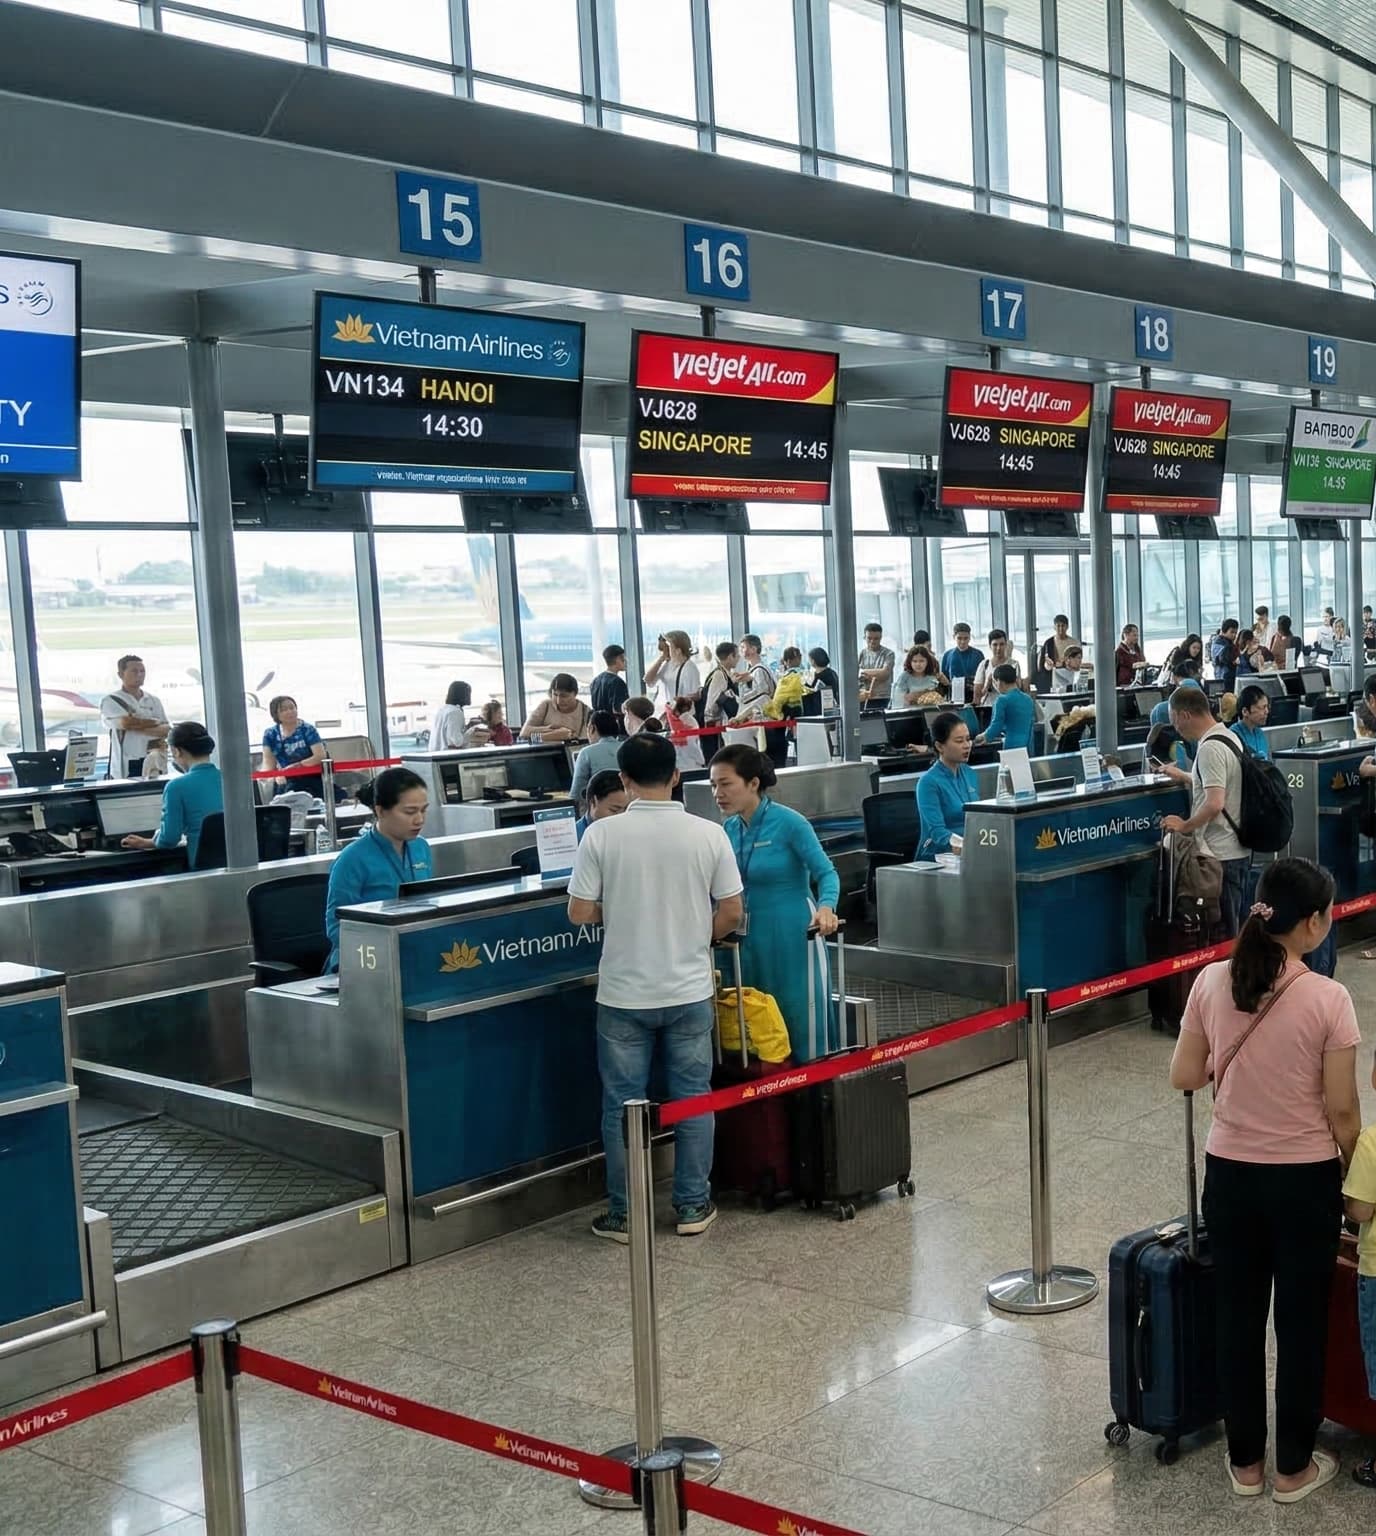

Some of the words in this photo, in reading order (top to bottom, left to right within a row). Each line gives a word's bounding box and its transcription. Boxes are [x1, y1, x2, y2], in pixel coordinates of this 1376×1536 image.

[408, 188, 473, 246] 15
[693, 238, 743, 288] 16
[987, 289, 1023, 329] 17
[1140, 315, 1169, 352] 18
[1312, 345, 1336, 378] 19
[326, 370, 404, 398] VN134
[421, 378, 493, 404] HANOI
[640, 398, 697, 421] VJ628
[422, 413, 483, 438] 14:30
[950, 423, 990, 442] VJ628
[1000, 427, 1076, 448] SINGAPORE
[1304, 421, 1355, 439] BAMBOO
[639, 430, 752, 455] SINGAPORE
[784, 440, 828, 459] 14:45
[1114, 437, 1147, 454] VJ628
[1153, 441, 1215, 459] SINGAPORE
[1000, 455, 1034, 472] 14:45
[1153, 464, 1181, 480] 14:45
[1287, 773, 1304, 788] 28
[356, 943, 376, 970] 15
[482, 931, 574, 964] Vietnam
[12, 1408, 69, 1438] Airlines
